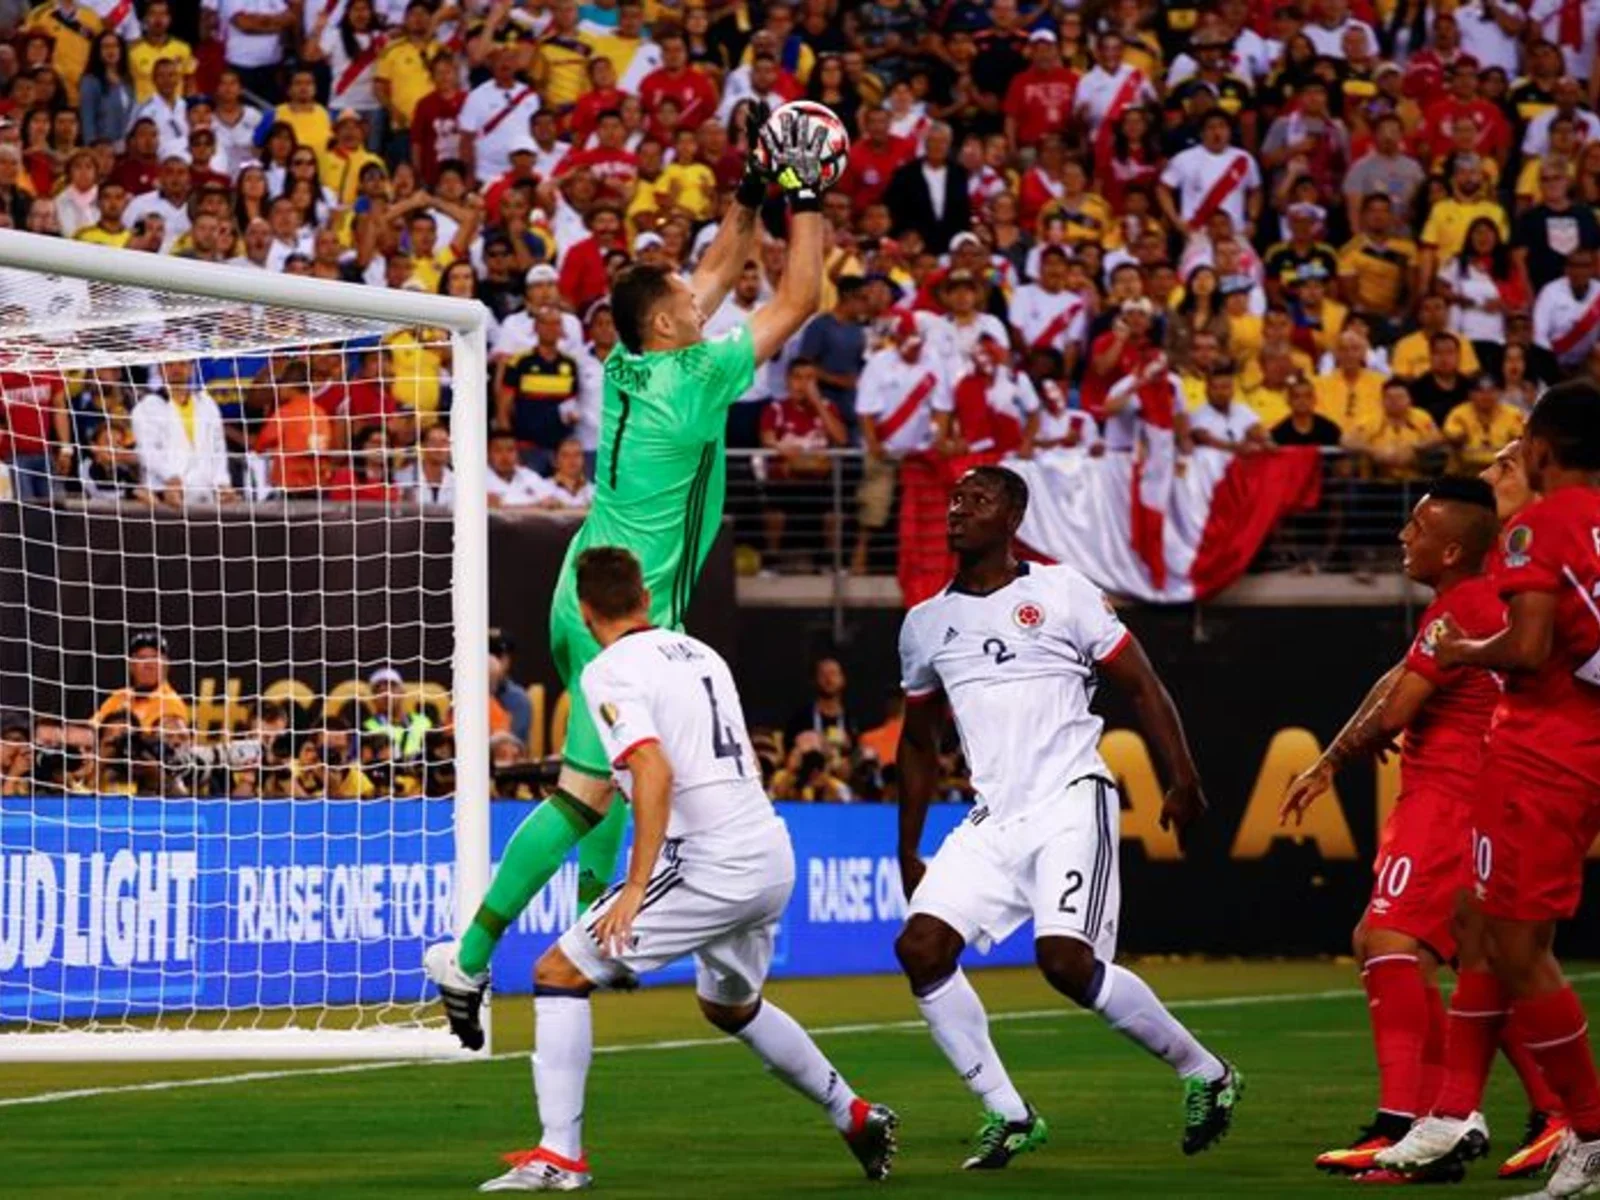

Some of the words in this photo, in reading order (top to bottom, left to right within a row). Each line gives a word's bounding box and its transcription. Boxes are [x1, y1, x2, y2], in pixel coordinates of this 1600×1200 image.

[610, 388, 631, 491] 1
[983, 638, 1016, 665] 2
[701, 676, 743, 778] 4
[63, 848, 197, 968] LIGHT
[237, 864, 323, 943] RAISE
[330, 863, 385, 941] ONE
[390, 861, 428, 938] TO
[808, 857, 873, 922] RAISE
[875, 857, 907, 922] ON
[1058, 870, 1084, 913] 2
